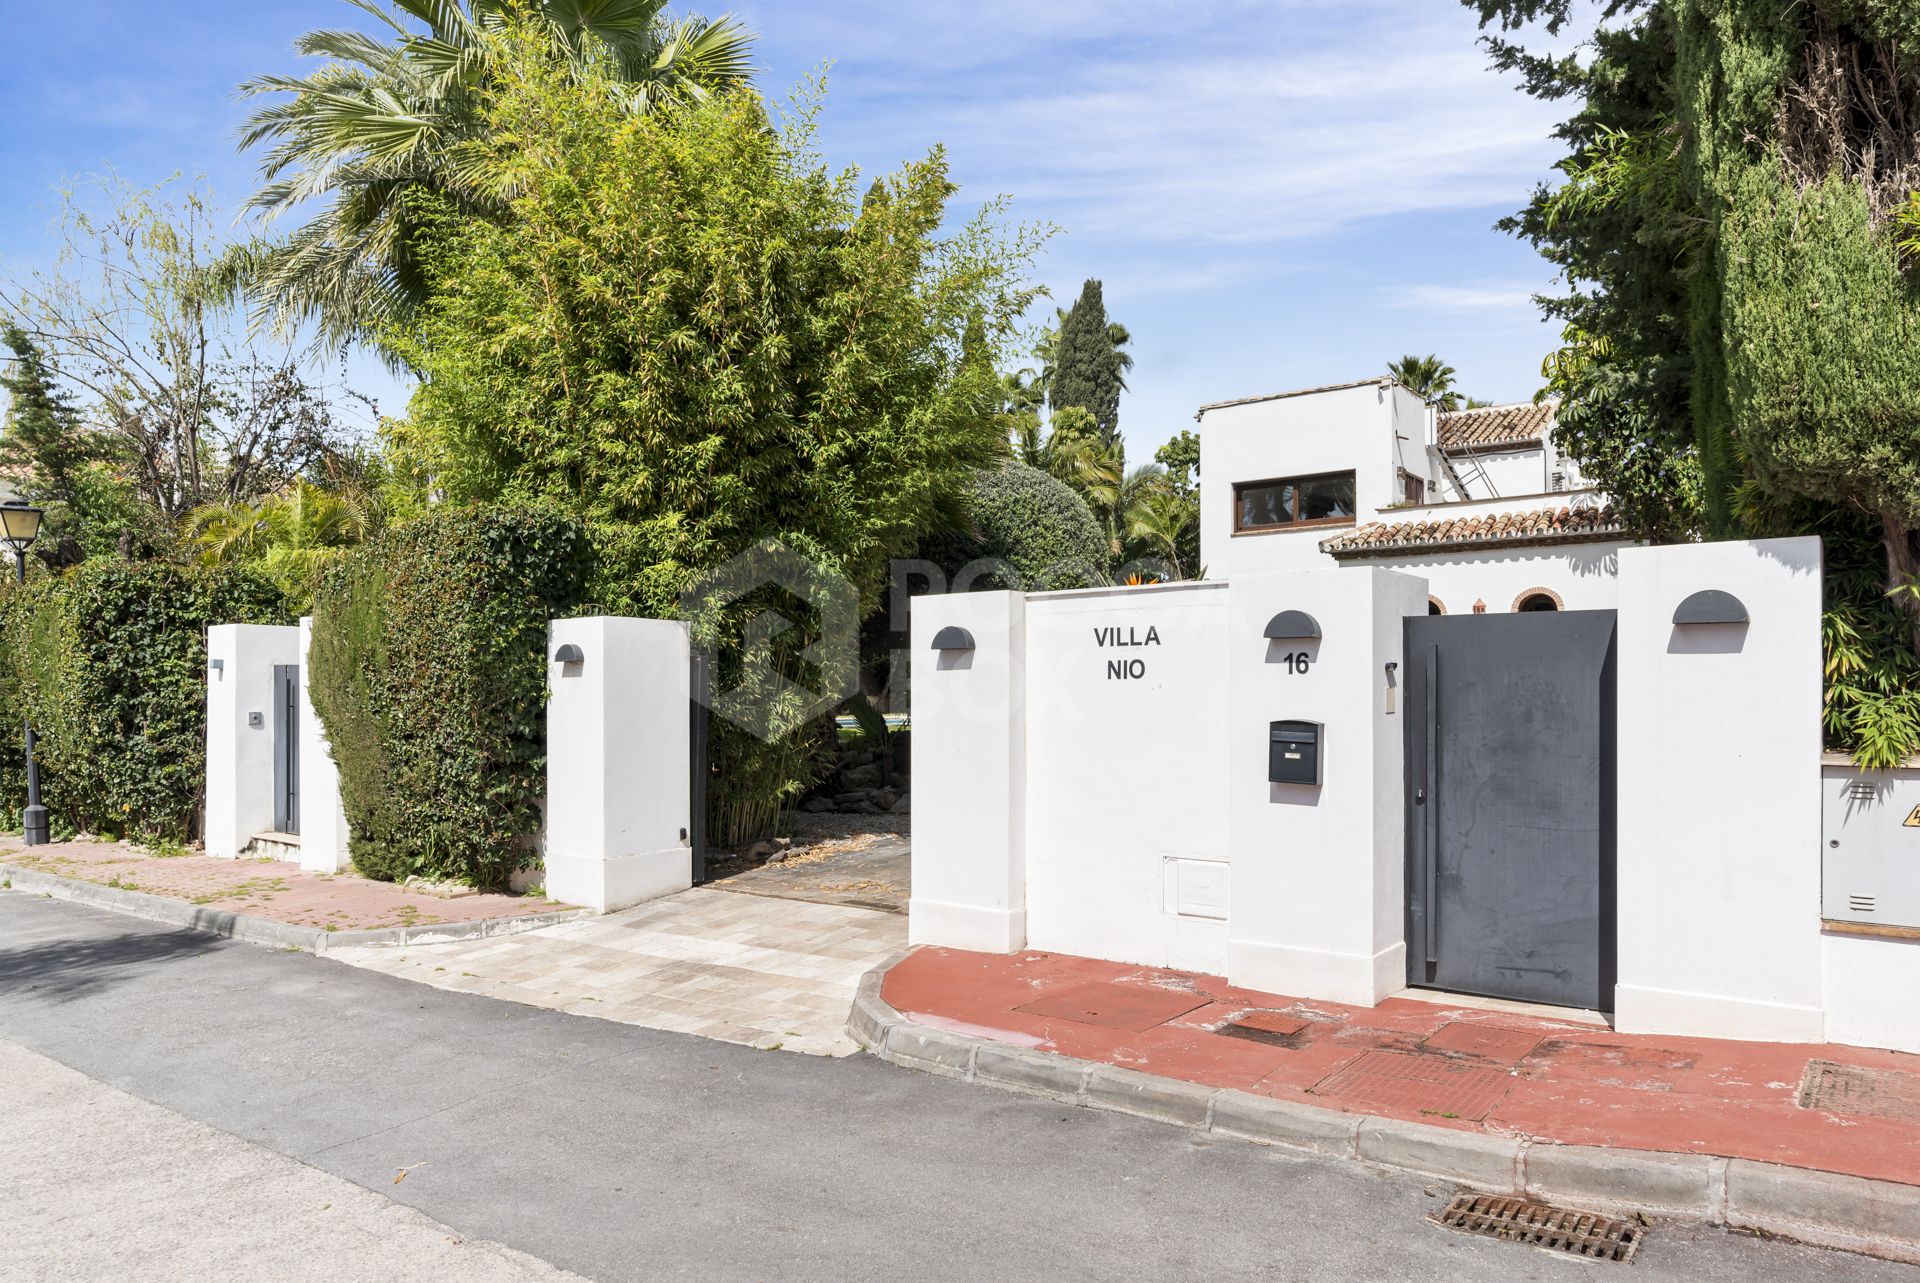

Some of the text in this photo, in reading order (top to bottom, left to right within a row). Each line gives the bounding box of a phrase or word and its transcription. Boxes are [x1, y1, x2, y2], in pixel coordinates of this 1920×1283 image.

[1094, 626, 1161, 647] VILLA
[1107, 659, 1146, 680] NIO
[1283, 652, 1309, 675] 16
